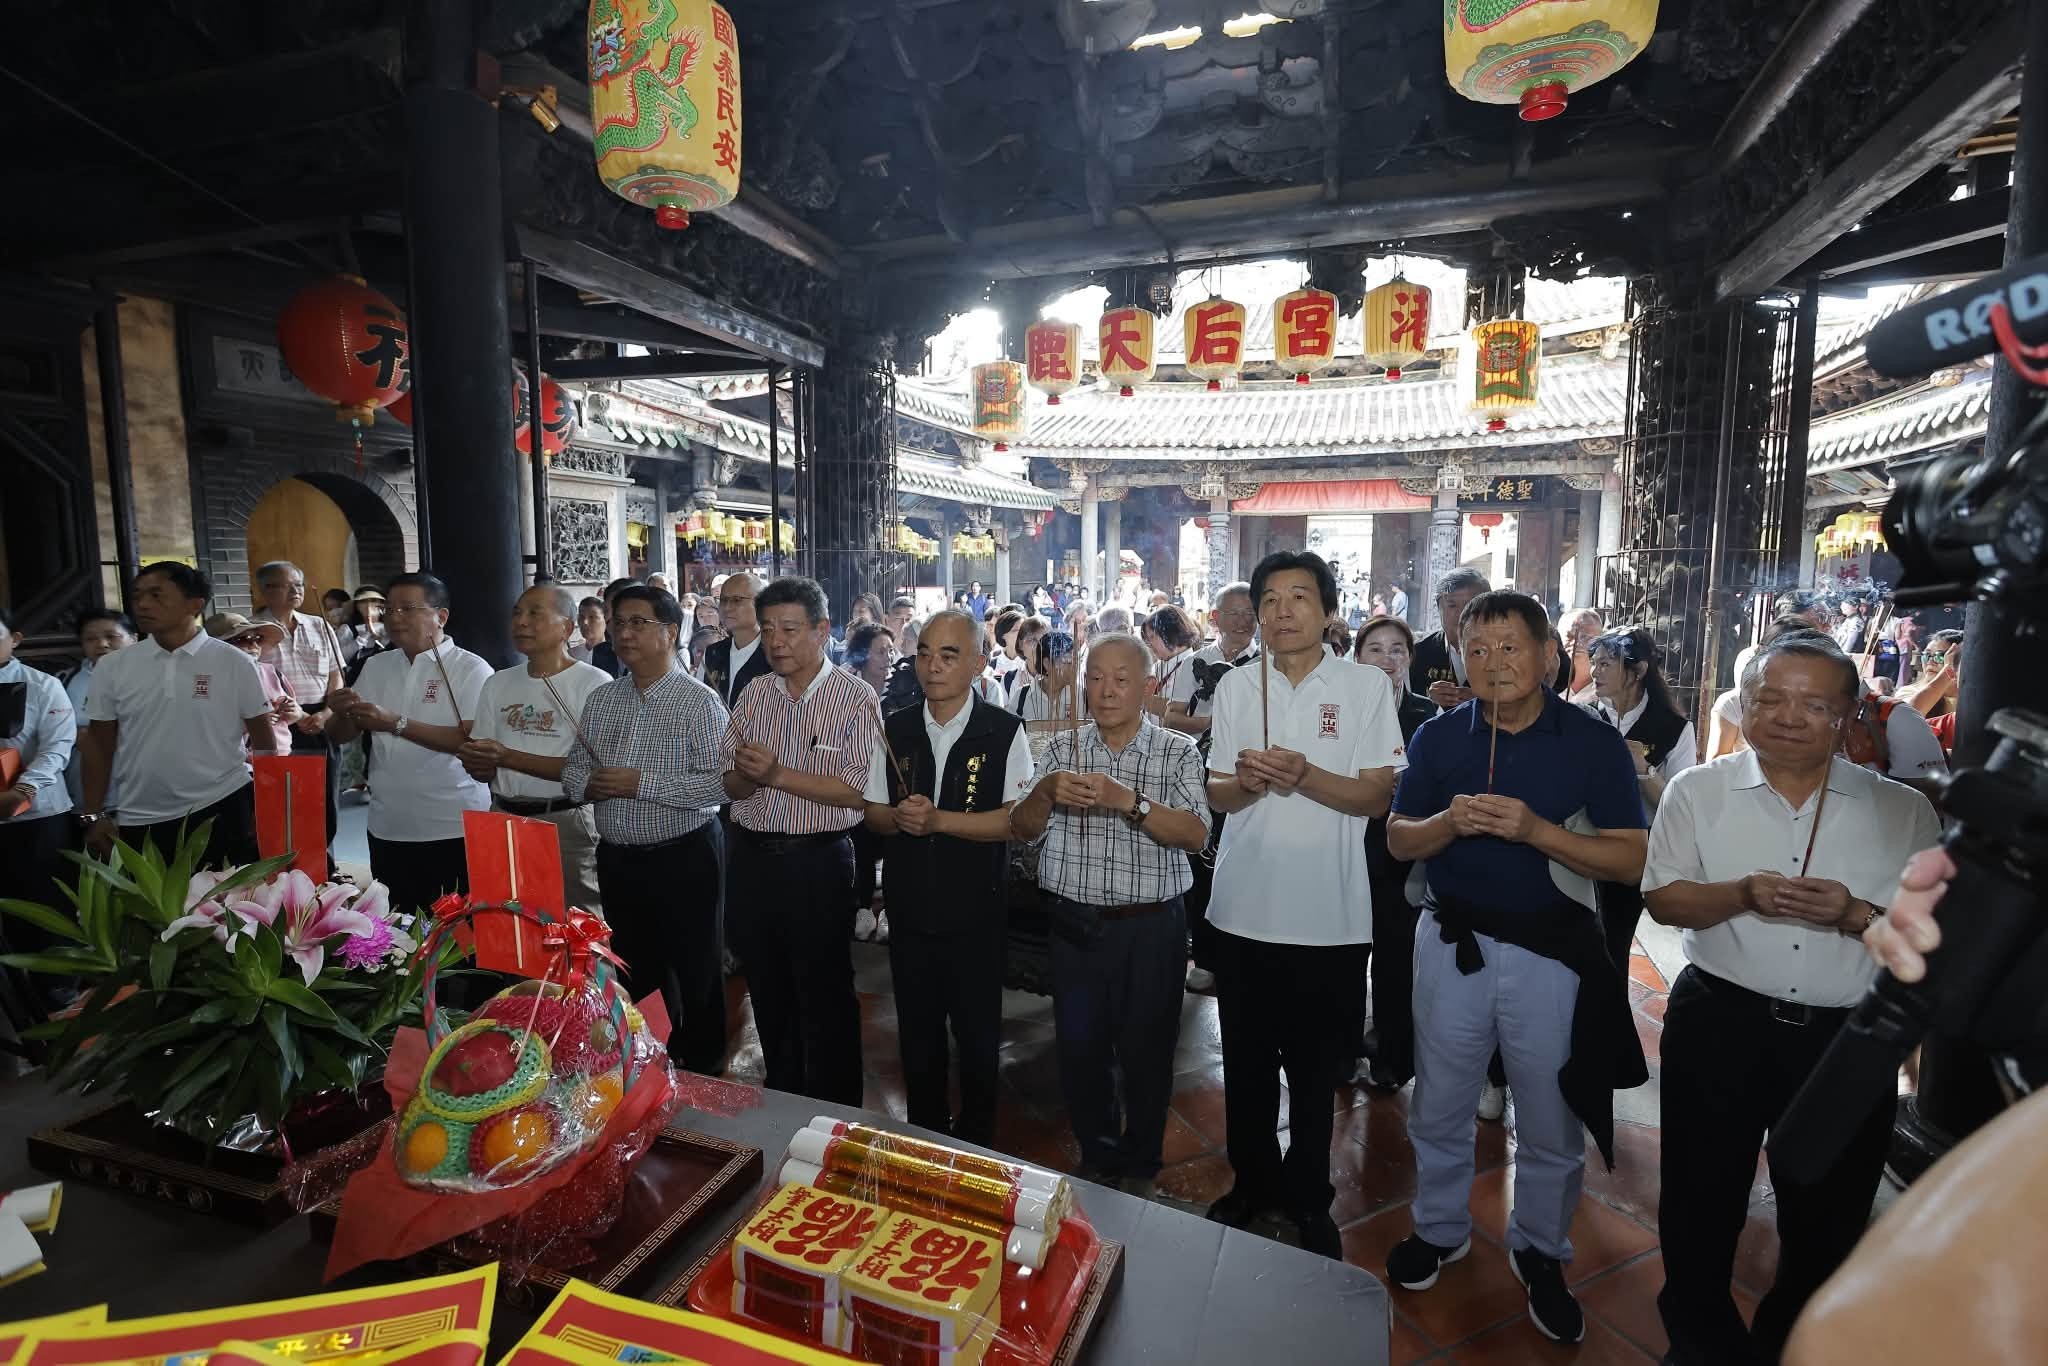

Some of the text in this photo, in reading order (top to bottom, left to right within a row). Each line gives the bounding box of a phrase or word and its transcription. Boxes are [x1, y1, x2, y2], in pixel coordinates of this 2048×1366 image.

[711, 5, 738, 175] 國泰民安
[1101, 310, 1149, 372] 天
[1189, 303, 1242, 365] 后
[1282, 289, 1335, 358] 宮
[748, 1186, 815, 1243] 財子壽
[773, 1196, 879, 1265] 福
[856, 1218, 922, 1281] 財子壽
[887, 1227, 993, 1303] 福
